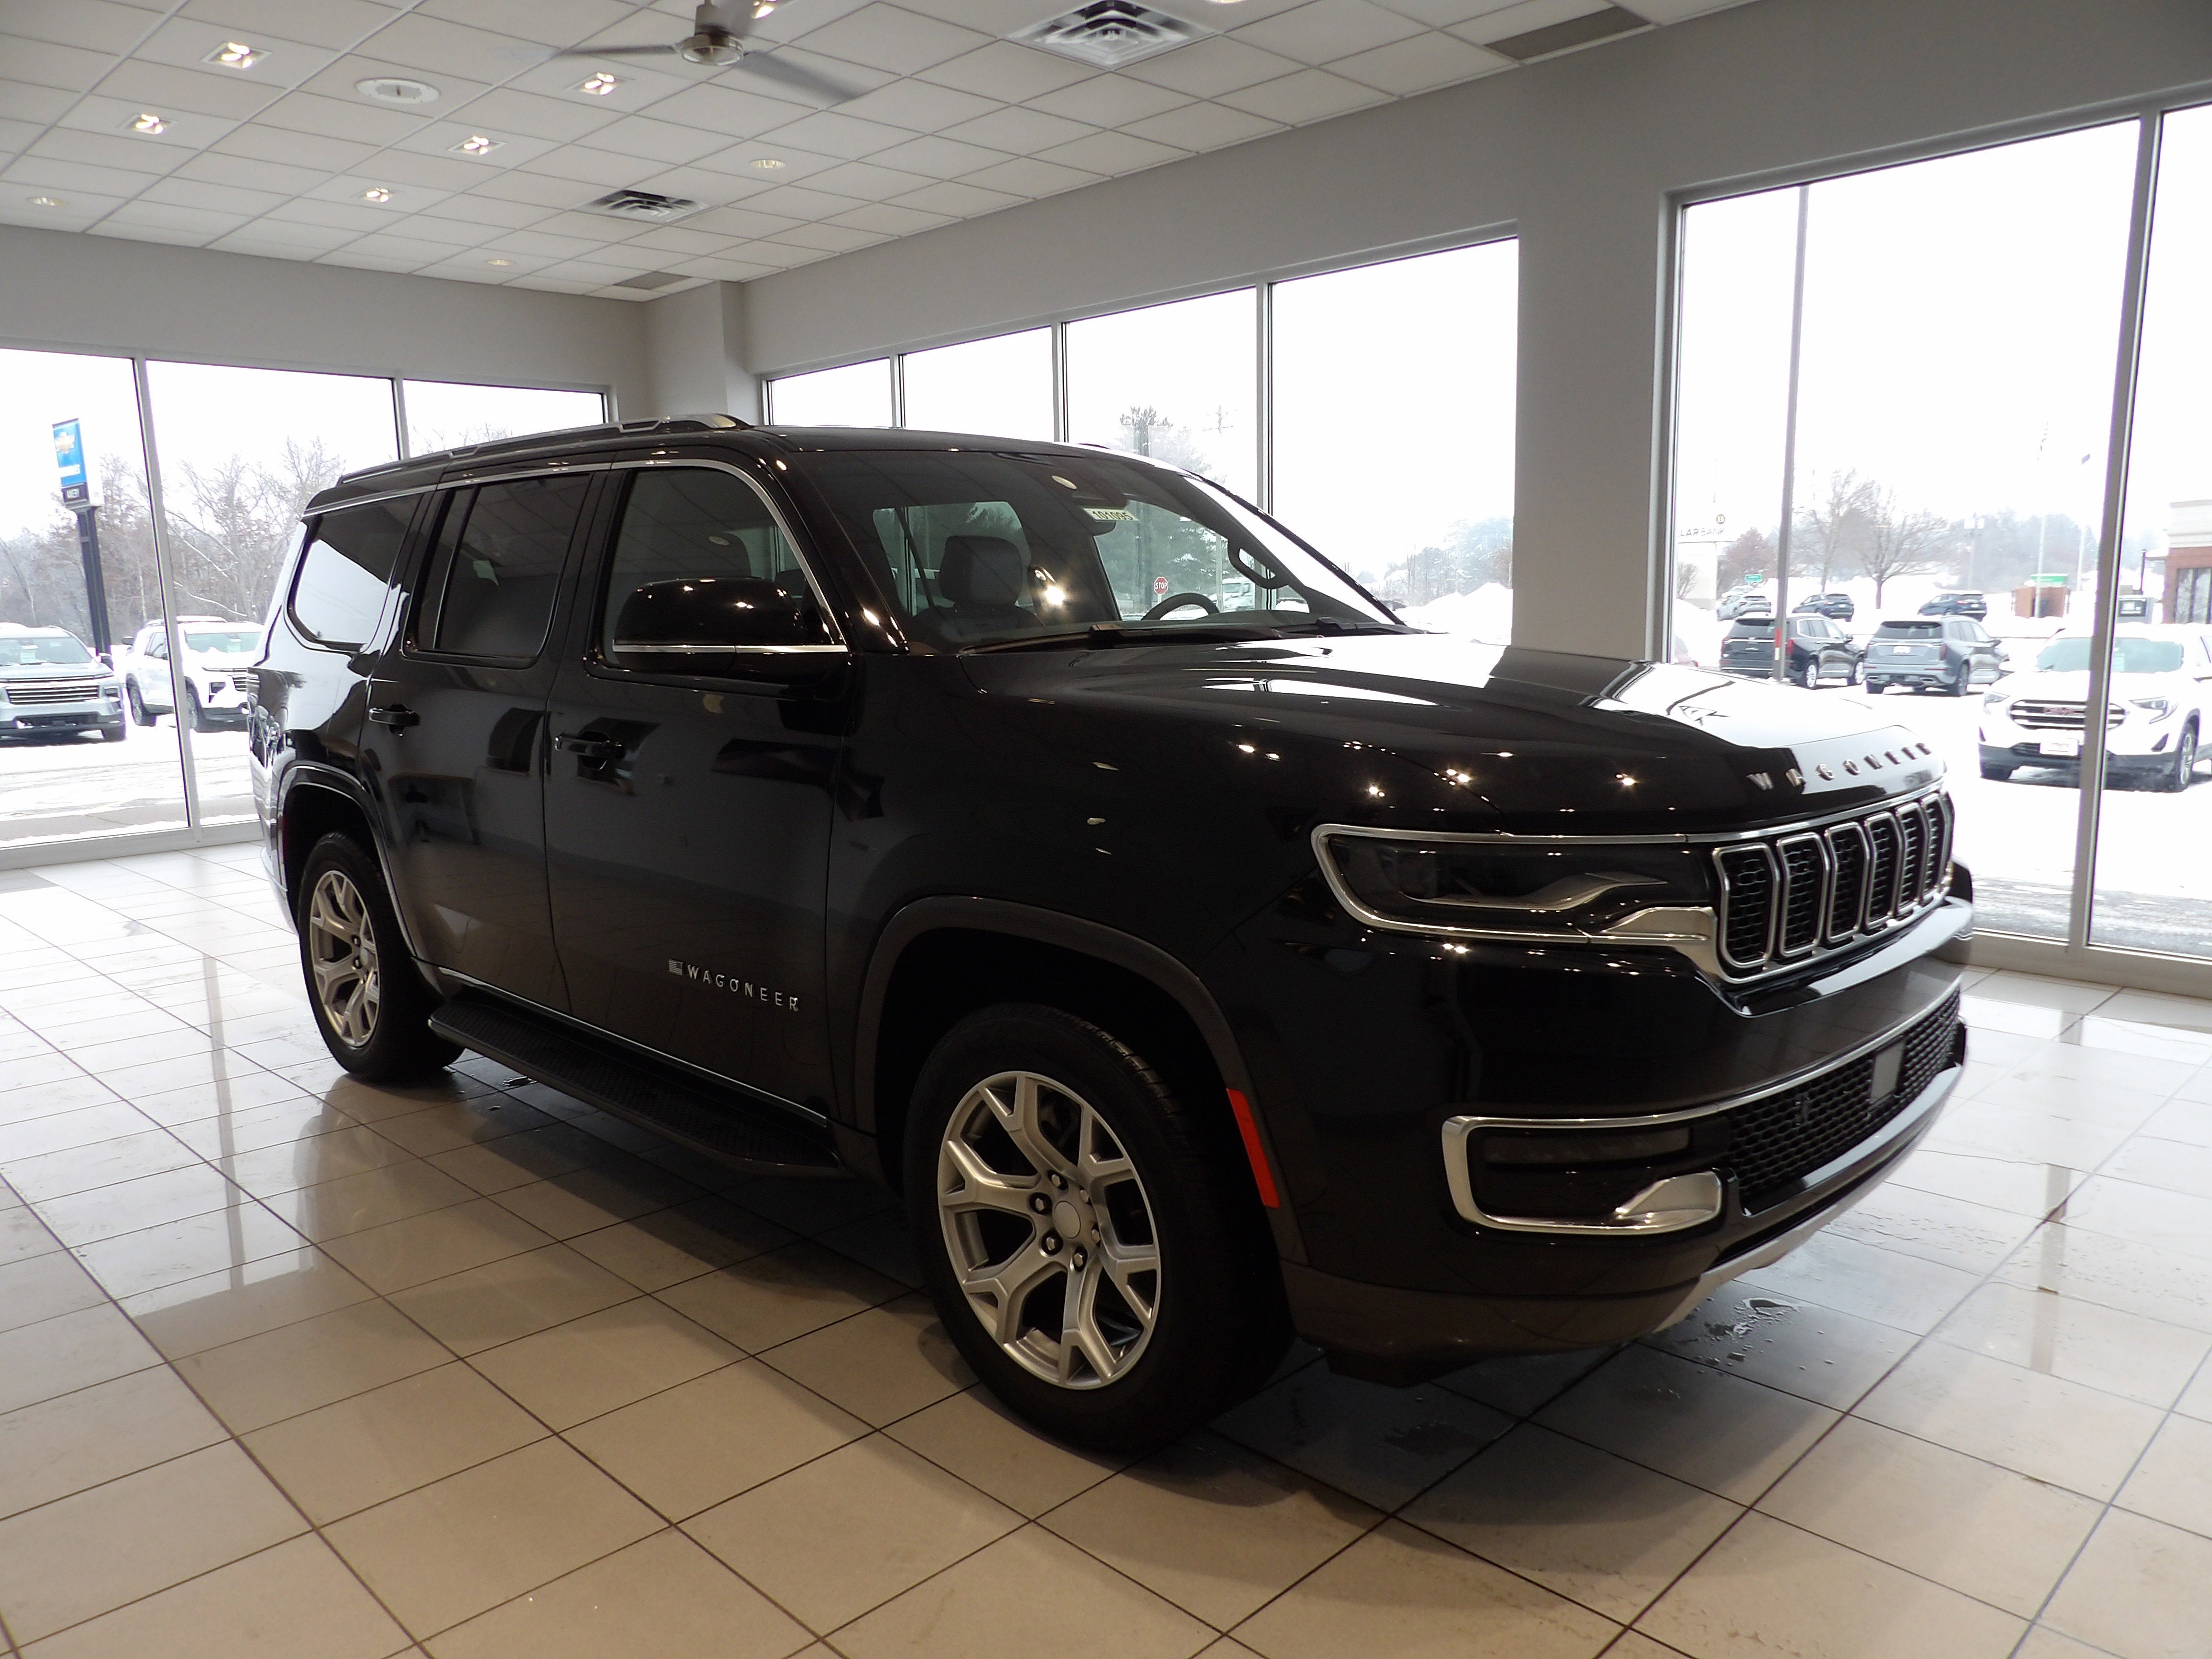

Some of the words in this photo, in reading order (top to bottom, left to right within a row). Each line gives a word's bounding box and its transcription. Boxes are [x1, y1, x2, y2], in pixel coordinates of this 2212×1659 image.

[1092, 511, 1133, 520] 101095
[1678, 528, 1698, 537] LAR
[1701, 528, 1725, 536] BANK
[2043, 707, 2085, 715] GMC
[1746, 743, 1931, 791] WAGONEER
[687, 964, 799, 1012] WAGONEER
